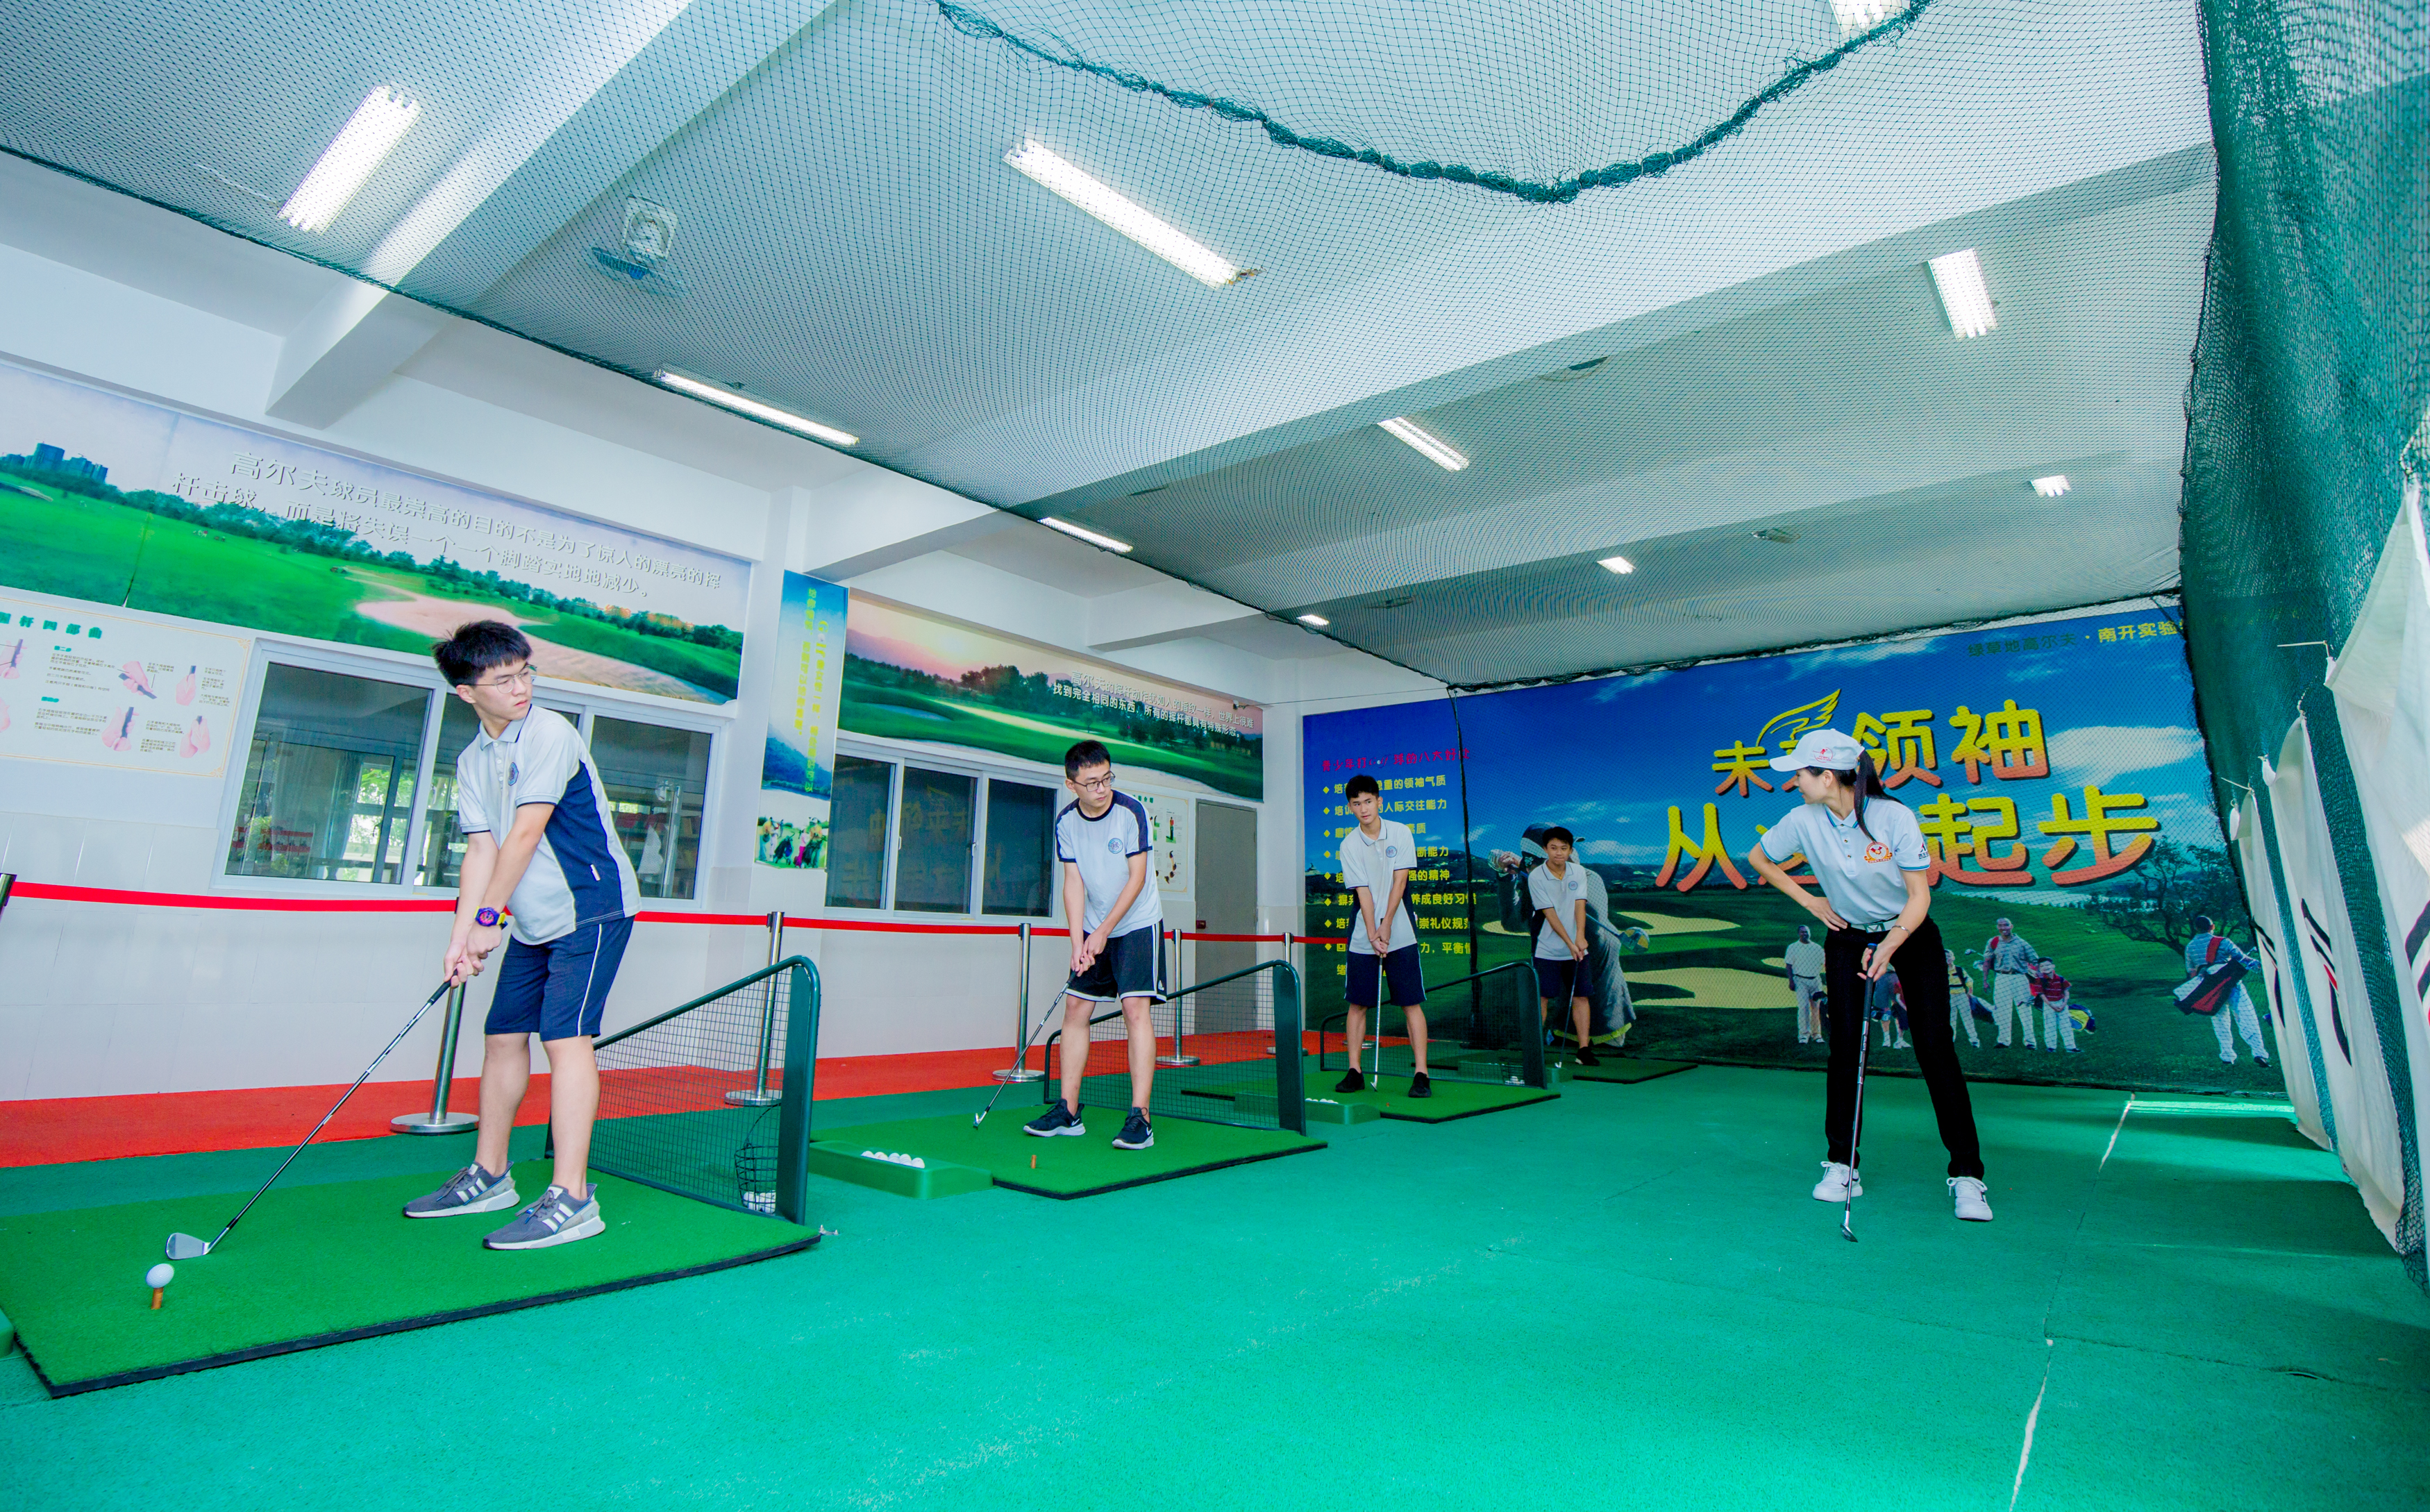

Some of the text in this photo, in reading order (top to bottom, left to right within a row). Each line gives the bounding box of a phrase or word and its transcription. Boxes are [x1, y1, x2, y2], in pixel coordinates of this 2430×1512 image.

[231, 451, 721, 589] 高尔夫球员最崇高的目的不是为了惊人的漂亮的挥
[1655, 785, 2161, 891] 从起步
